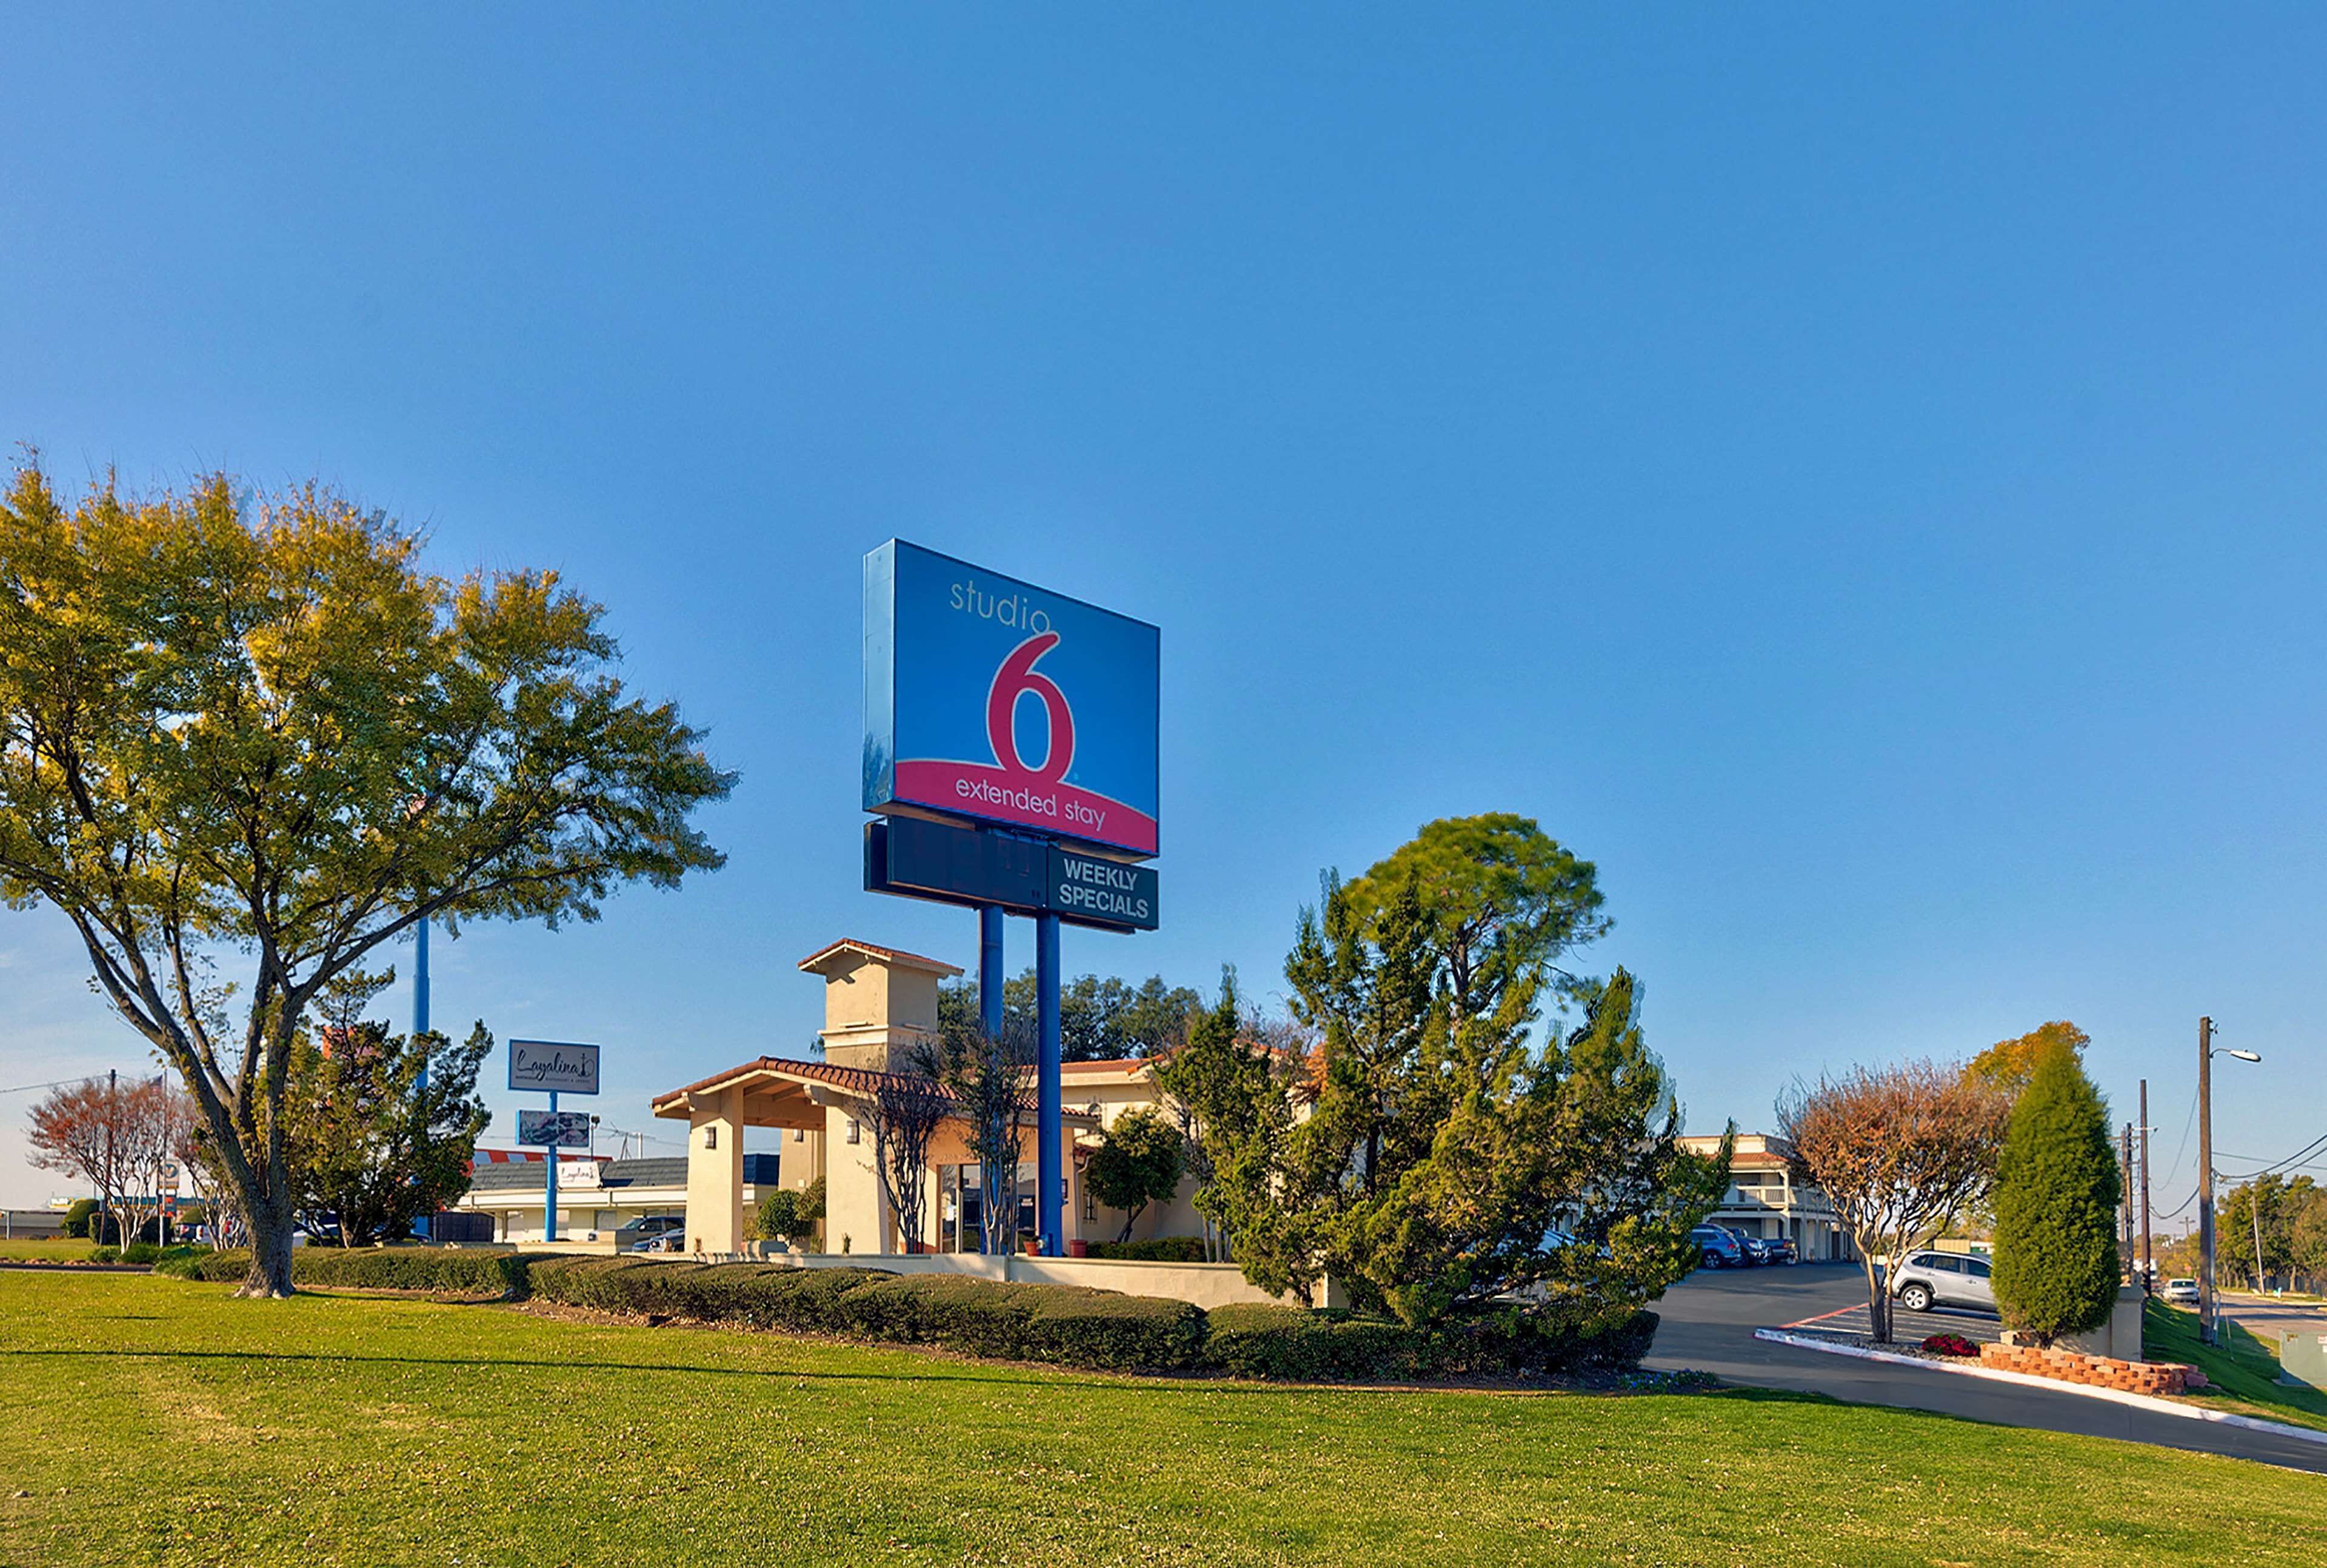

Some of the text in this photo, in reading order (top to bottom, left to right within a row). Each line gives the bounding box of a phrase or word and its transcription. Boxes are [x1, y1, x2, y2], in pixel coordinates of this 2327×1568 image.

[950, 580, 1050, 635] studio
[986, 630, 1075, 784] 6
[955, 778, 1106, 832] extended stay
[1063, 858, 1138, 892] WEEKLY
[1059, 883, 1149, 919] SPECIALS
[516, 1049, 579, 1082] Layalina
